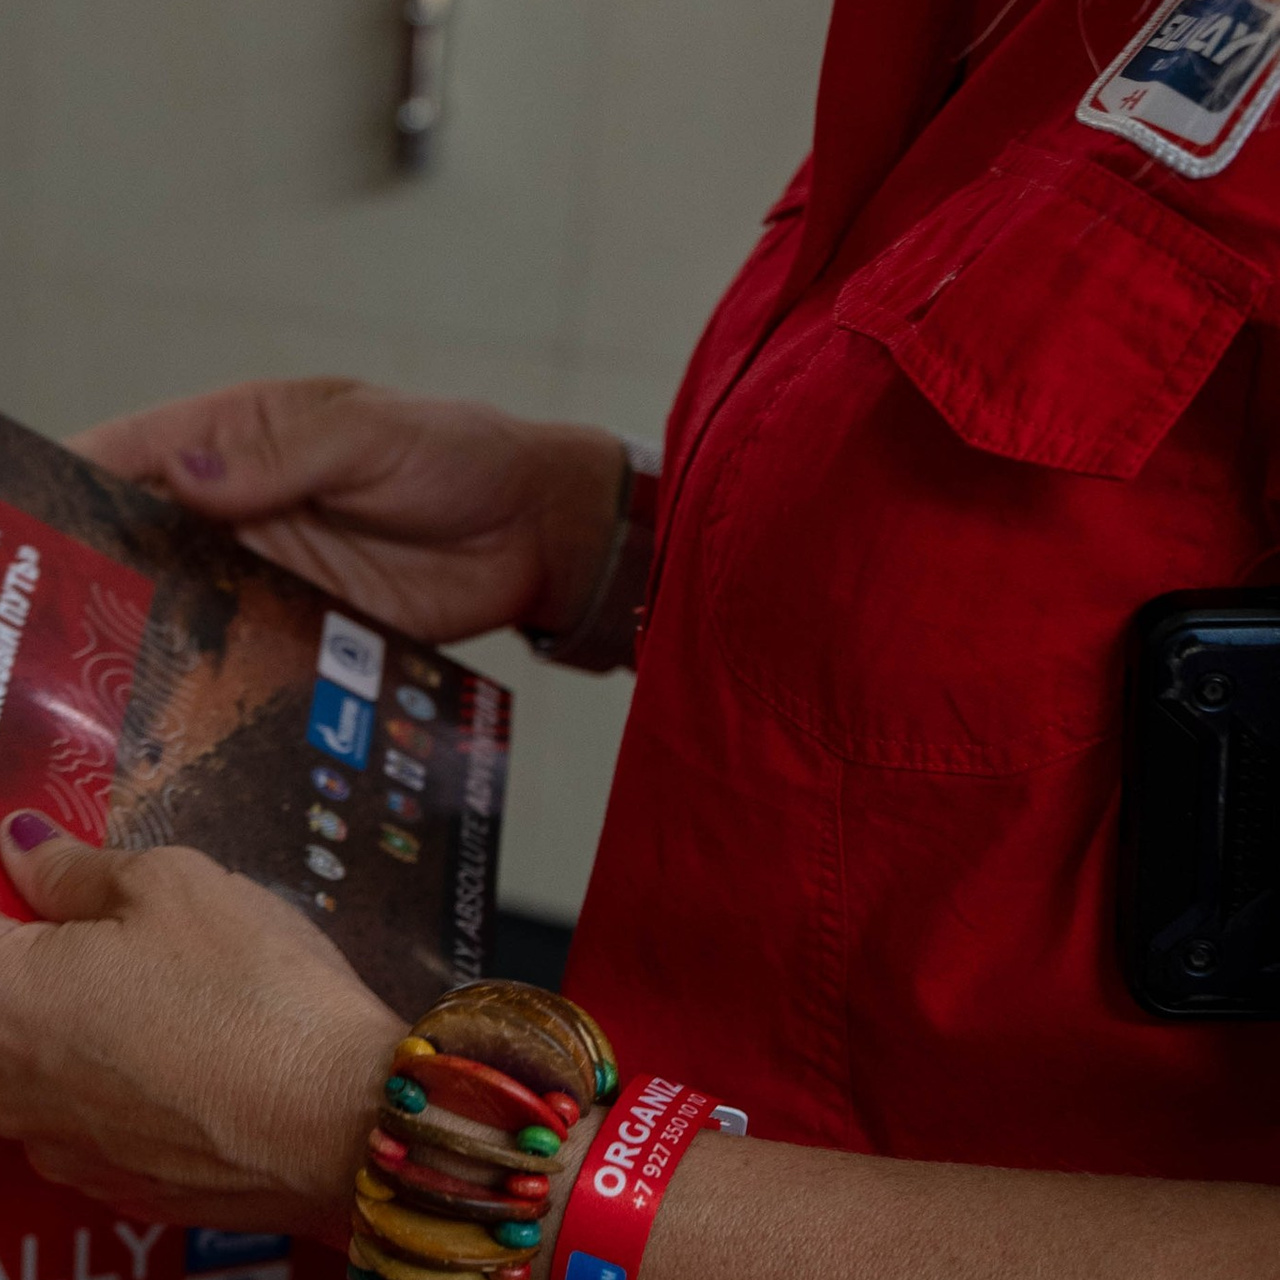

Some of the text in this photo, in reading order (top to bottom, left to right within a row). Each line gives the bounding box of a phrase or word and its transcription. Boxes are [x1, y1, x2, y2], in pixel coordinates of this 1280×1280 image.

[593, 1077, 684, 1198] ORGANIZ
[633, 1093, 707, 1209] +7 927 350 10 10
